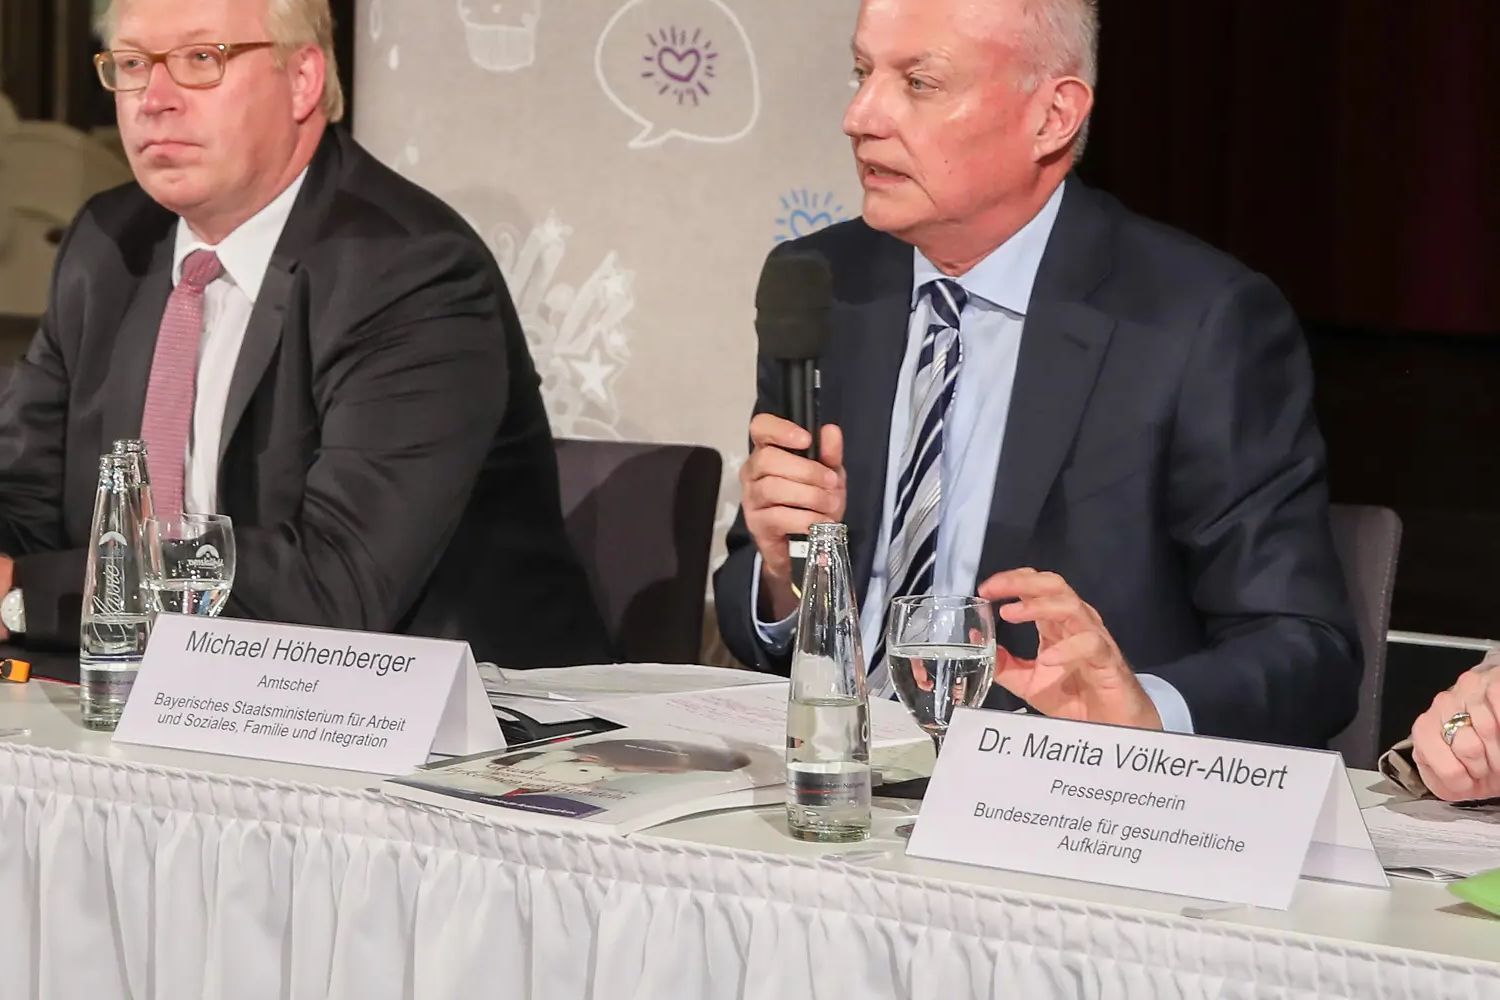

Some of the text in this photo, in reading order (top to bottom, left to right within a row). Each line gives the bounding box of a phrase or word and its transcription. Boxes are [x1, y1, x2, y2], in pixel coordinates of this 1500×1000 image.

[185, 630, 416, 676] Michael Höhenberger
[257, 675, 319, 693] Amtschef
[154, 693, 406, 731] Bayerisches Staatsministerium für Arbeit
[157, 712, 387, 749] und Soziales, Familie und Integration
[977, 727, 1289, 790] Dr. Marita Völker-Albert
[1050, 779, 1186, 811] Pressesprecherin
[973, 802, 1245, 854] Bundeszentrale für gesundheitliche
[1057, 835, 1143, 864] Aufklärung
